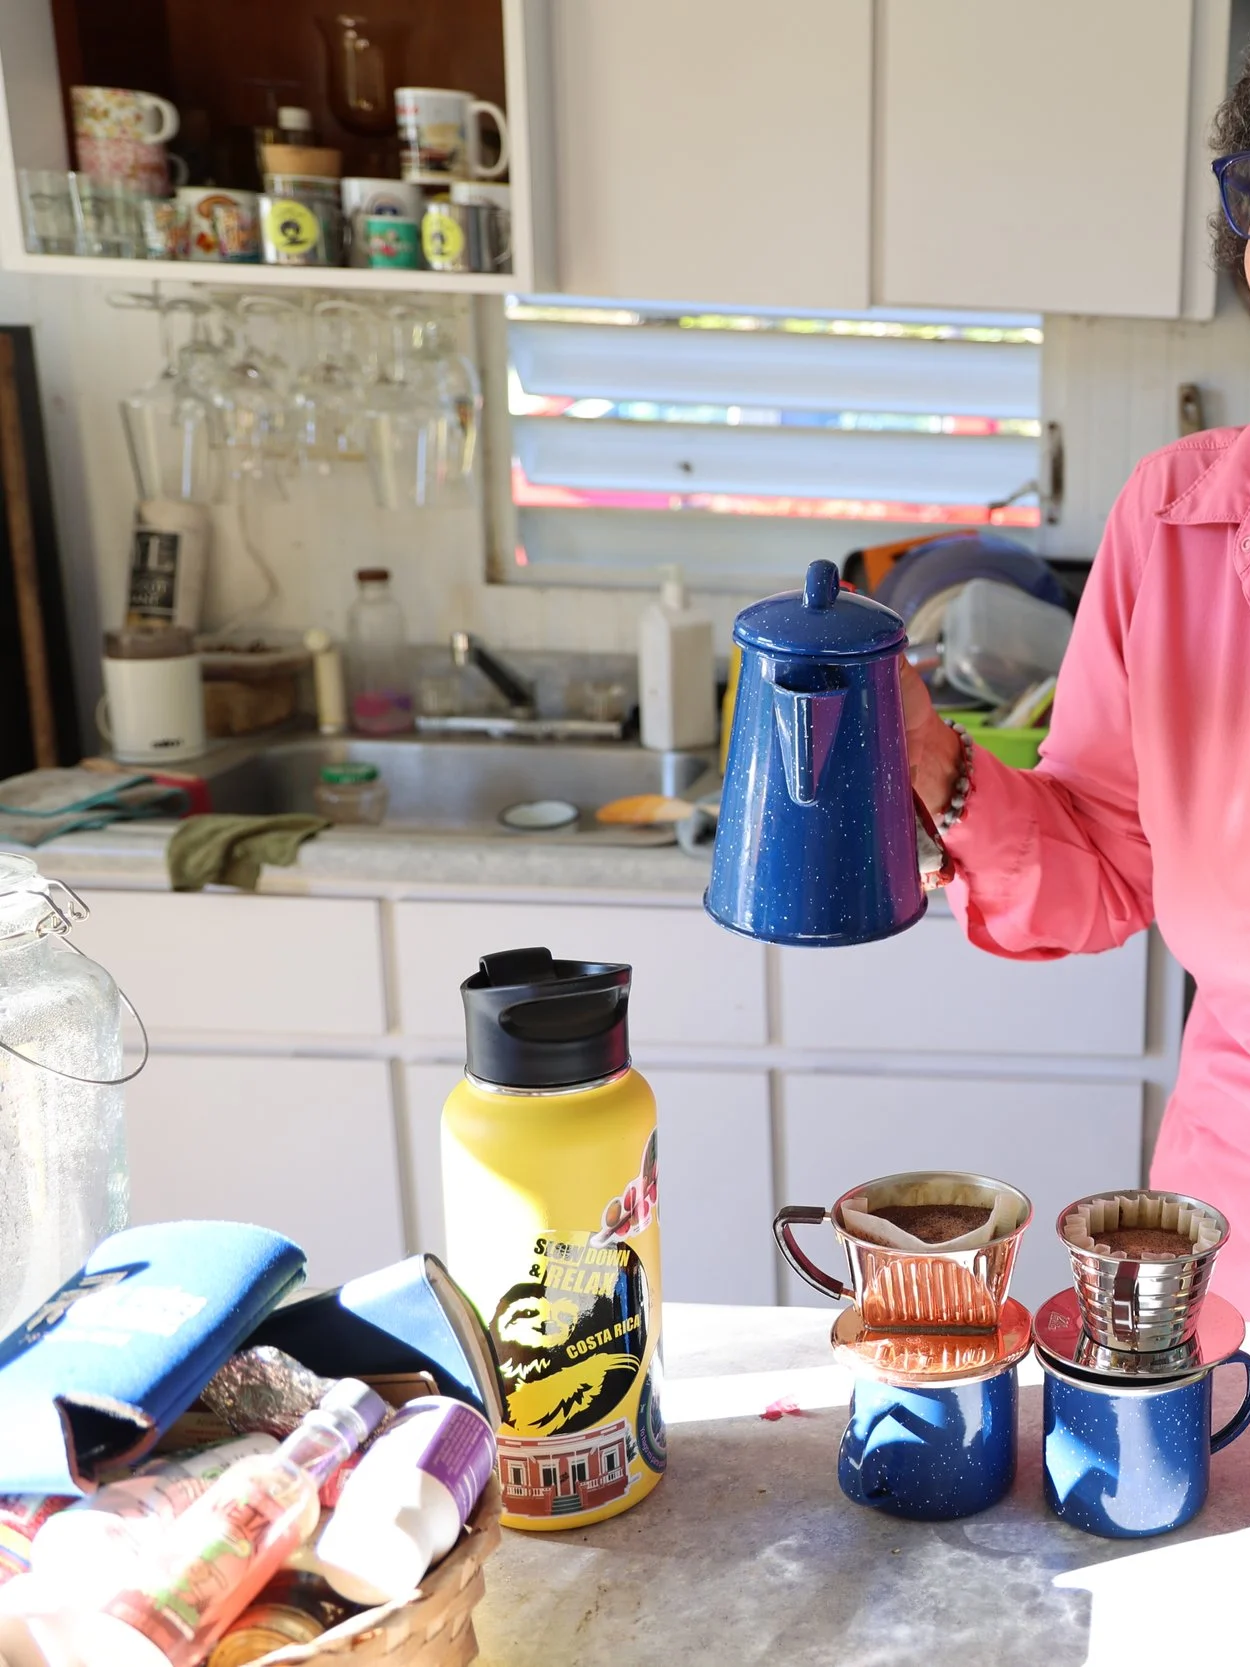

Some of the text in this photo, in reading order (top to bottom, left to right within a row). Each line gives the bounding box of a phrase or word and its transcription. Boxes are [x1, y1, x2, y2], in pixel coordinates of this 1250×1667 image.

[534, 1238, 630, 1268] SLOW DOWN
[529, 1264, 617, 1297] & RELAX
[566, 1314, 640, 1359] COSTA RICA
